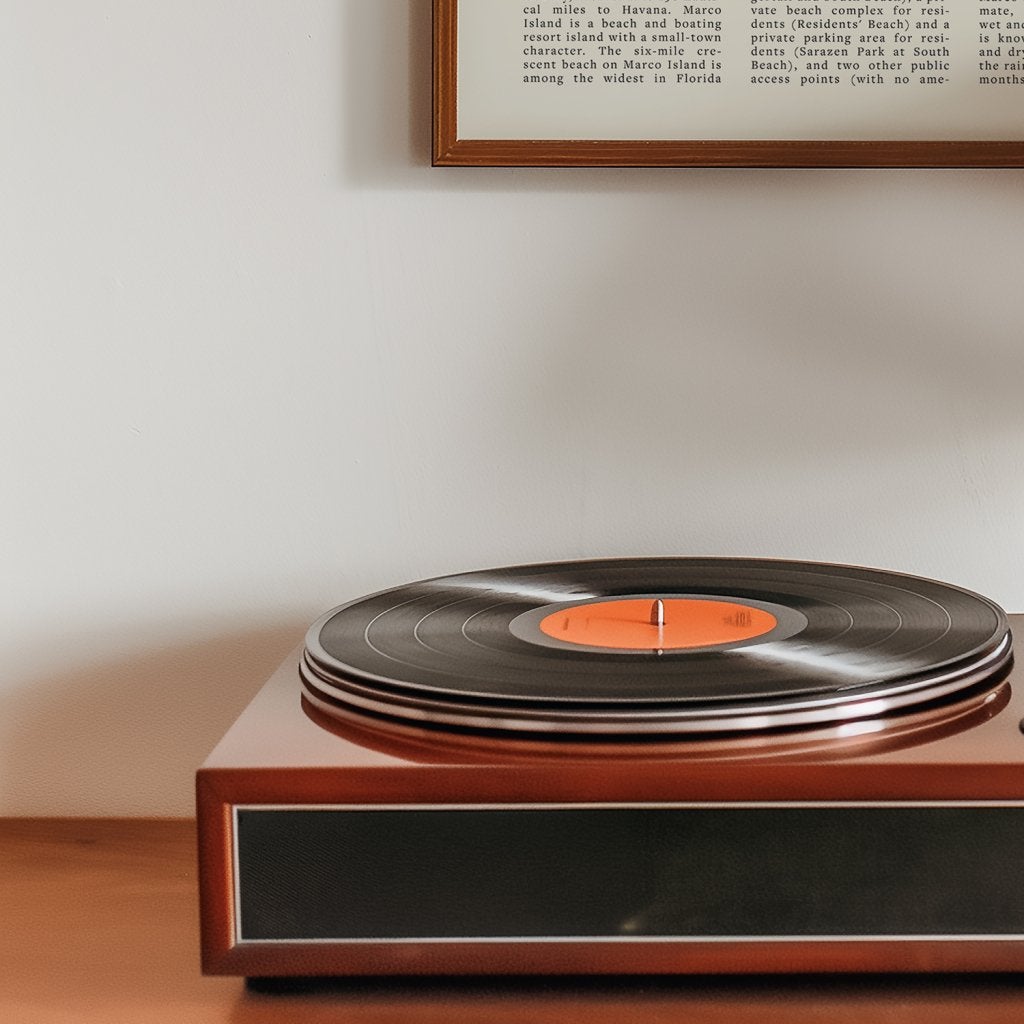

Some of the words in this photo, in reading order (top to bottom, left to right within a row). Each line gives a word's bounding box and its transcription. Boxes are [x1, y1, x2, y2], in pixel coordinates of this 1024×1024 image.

[523, 4, 541, 14] cal
[552, 4, 586, 14] miles
[597, 5, 611, 14] to
[622, 4, 671, 14] Havana.
[683, 4, 722, 14] Marco
[751, 5, 777, 15] vate
[786, 5, 822, 15] beach
[831, 5, 884, 18] complex
[893, 5, 912, 15] for
[921, 5, 950, 15] resi-
[979, 6, 1014, 18] mate,
[523, 32, 561, 42] resort
[566, 32, 604, 42] island
[608, 32, 636, 42] with
[640, 34, 647, 42] a
[651, 32, 721, 42] small-town
[751, 32, 795, 46] private
[803, 32, 851, 46] parking
[859, 35, 886, 43] area
[894, 32, 913, 43] for
[921, 32, 949, 43] resi-
[979, 33, 990, 43] is
[523, 45, 586, 56] character.
[598, 45, 622, 56] The
[634, 45, 685, 56] six-mile
[696, 48, 721, 56] cre-
[751, 46, 785, 56] dents
[794, 46, 848, 59] (Sarazen
[857, 46, 885, 56] Park
[893, 47, 905, 56] at
[913, 46, 949, 56] South
[979, 47, 1001, 57] and
[523, 59, 556, 69] scent
[562, 59, 597, 69] beach
[623, 59, 662, 69] Marco
[667, 59, 706, 69] Island
[711, 59, 722, 69] is
[751, 60, 798, 73] Beach),
[806, 60, 828, 70] and
[837, 61, 860, 70] two
[868, 60, 903, 70] other
[911, 60, 950, 73] public
[979, 60, 999, 71] the
[523, 75, 564, 86] among
[573, 73, 594, 83] the
[603, 73, 644, 83] widest
[654, 73, 666, 83] in
[677, 73, 721, 83] Florida
[750, 76, 790, 84] access
[800, 73, 840, 87] points
[850, 73, 884, 87] (with
[894, 76, 910, 84] no
[919, 76, 949, 84] ame-
